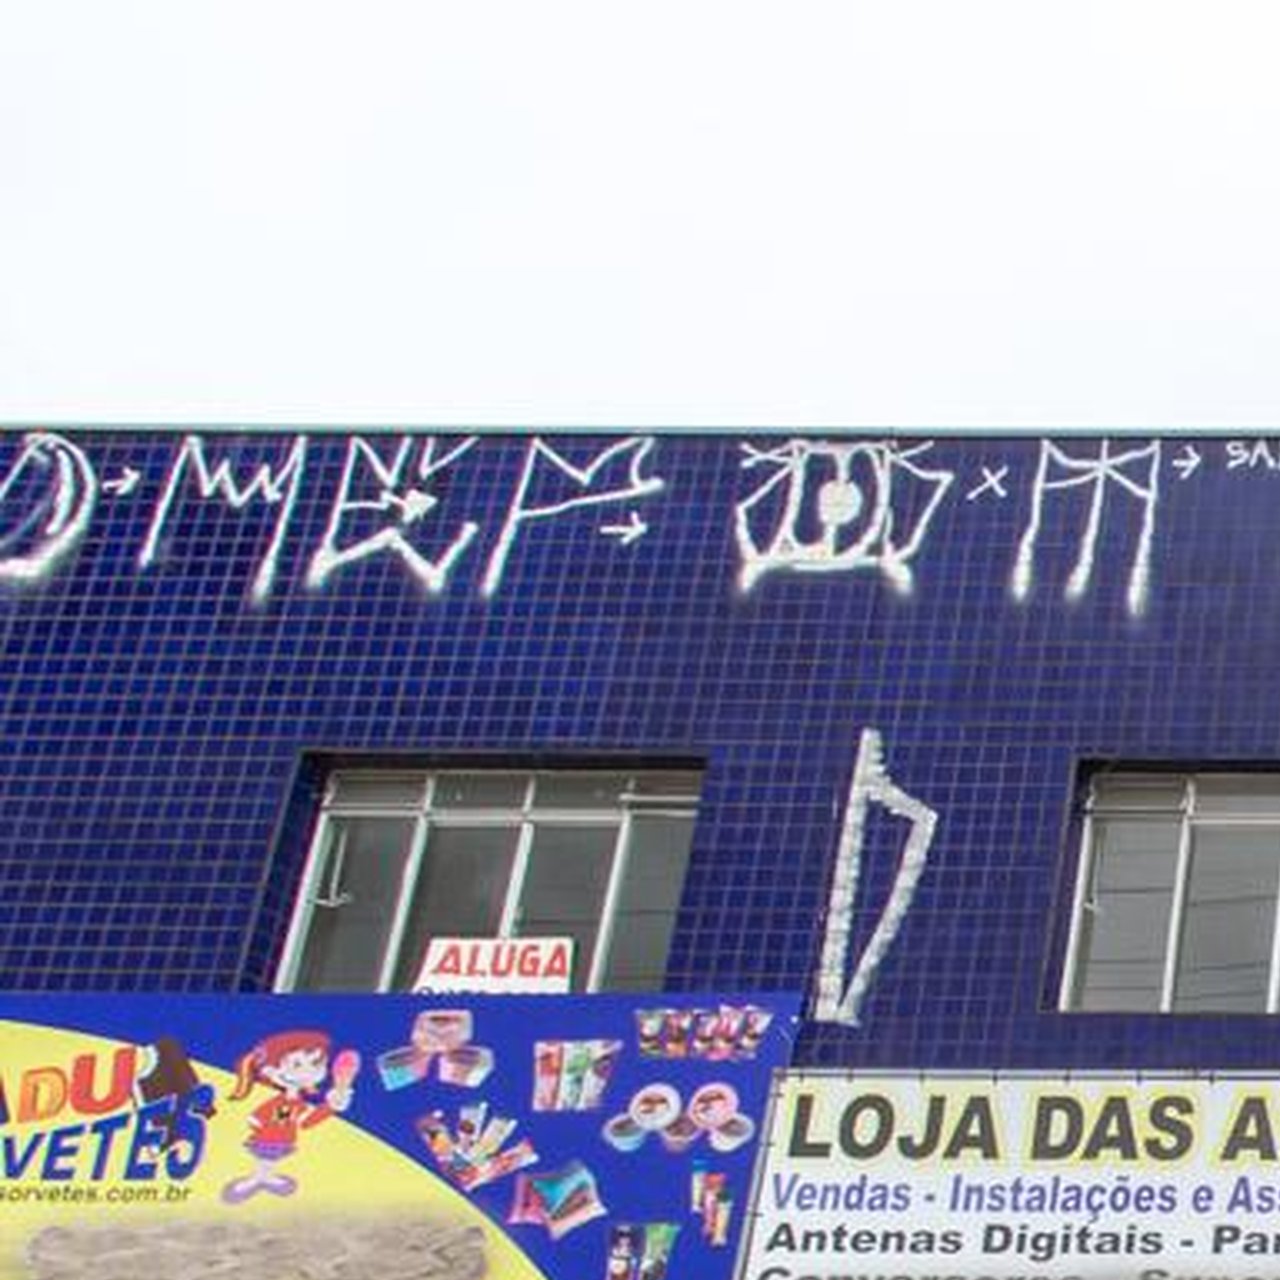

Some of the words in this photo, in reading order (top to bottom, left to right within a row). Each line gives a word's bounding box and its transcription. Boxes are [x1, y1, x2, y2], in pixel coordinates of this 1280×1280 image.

[431, 942, 568, 977] ALUGA
[0, 1047, 137, 1124] DU
[788, 1094, 999, 1160] LOJA
[1030, 1095, 1195, 1161] DAS
[772, 1173, 912, 1212] Vendas
[949, 1173, 1177, 1222] Instalações
[1192, 1183, 1215, 1213] e
[764, 1223, 964, 1254] Antenas
[982, 1223, 1165, 1263] Digitais
